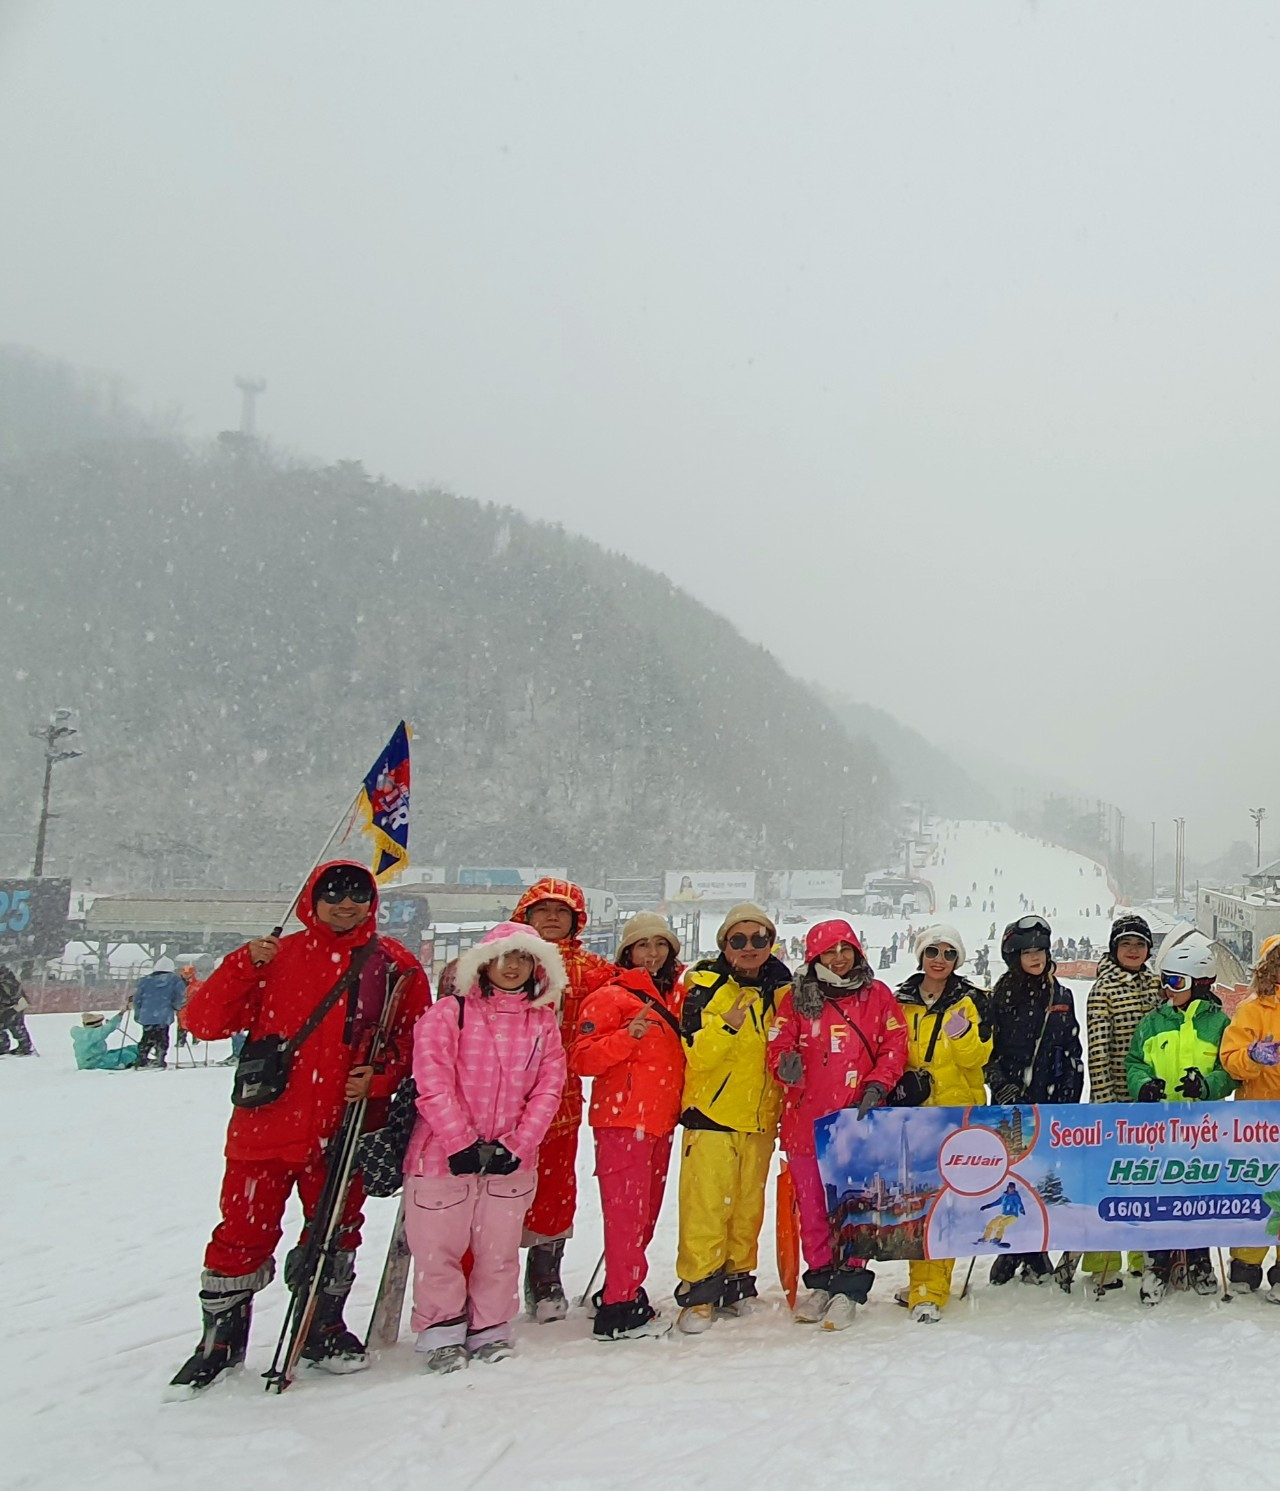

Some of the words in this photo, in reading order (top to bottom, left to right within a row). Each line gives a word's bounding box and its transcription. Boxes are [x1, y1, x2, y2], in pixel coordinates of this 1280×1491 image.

[1051, 1120, 1102, 1148] Seoul
[1116, 1118, 1166, 1152] Trượt
[1169, 1114, 1218, 1150] Tuyết
[1233, 1117, 1280, 1143] Lotte
[945, 1154, 1003, 1167] JEJUair
[1108, 1156, 1160, 1185] Hái
[1161, 1157, 1220, 1185] Dâu
[1108, 1201, 1151, 1218] 16/01
[1172, 1198, 1262, 1217] 20/01/2024
